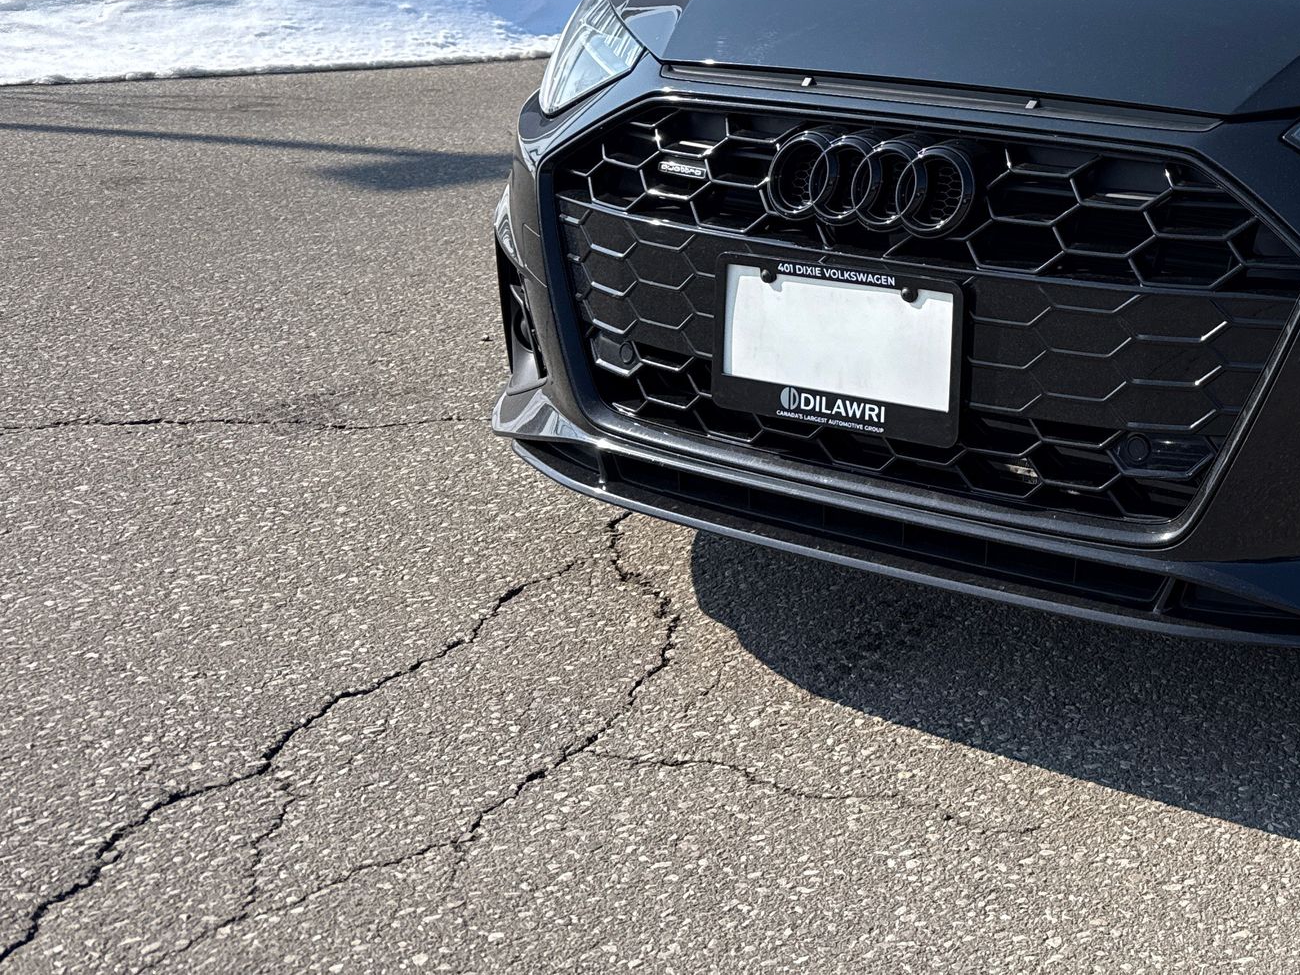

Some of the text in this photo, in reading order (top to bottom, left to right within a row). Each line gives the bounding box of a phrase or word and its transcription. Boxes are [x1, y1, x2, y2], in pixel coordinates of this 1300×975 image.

[777, 263, 896, 286] 401 DIXIE VOLKSWAGEN
[800, 392, 886, 423] DILAWRI
[803, 414, 828, 424] LARGEST
[828, 418, 864, 430] AUTOMOTIVE
